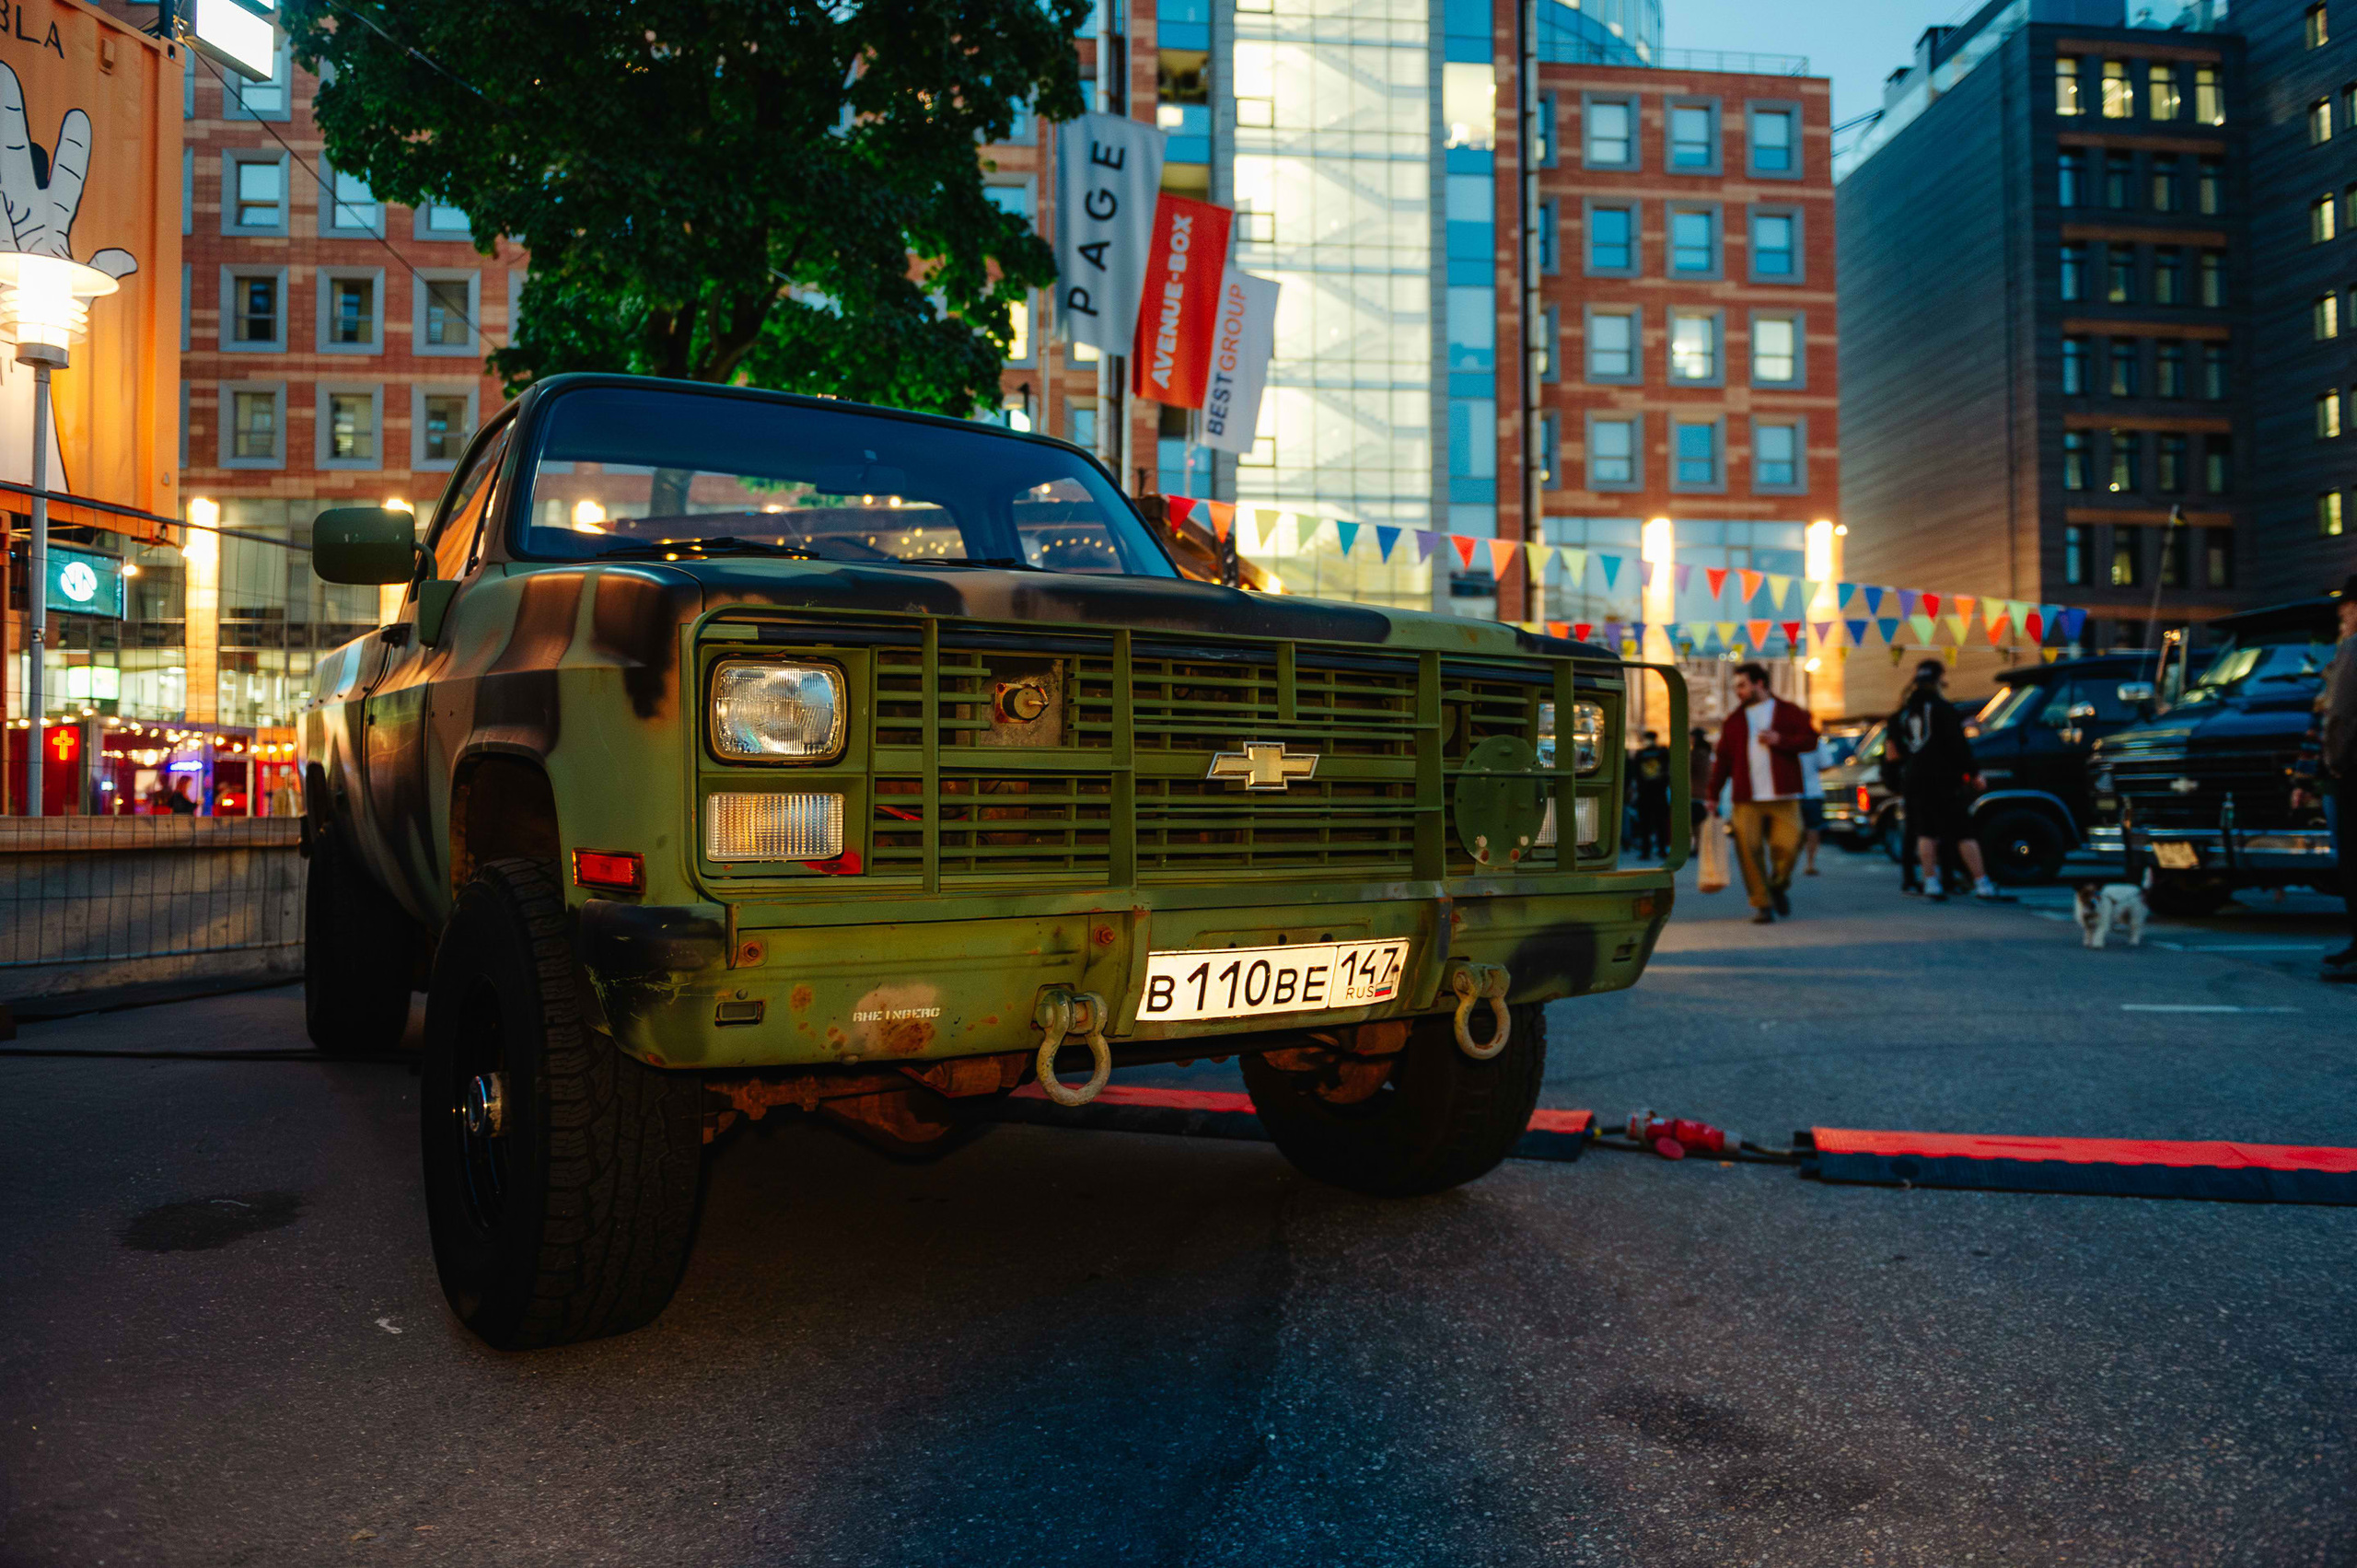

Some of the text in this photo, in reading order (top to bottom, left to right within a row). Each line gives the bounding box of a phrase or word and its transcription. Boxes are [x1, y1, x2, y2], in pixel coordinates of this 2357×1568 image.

[1067, 140, 1126, 318] PAGE
[1151, 213, 1193, 390] AVENUE-BOX
[1341, 947, 1399, 987] 147
[1345, 984, 1375, 1001] RUS
